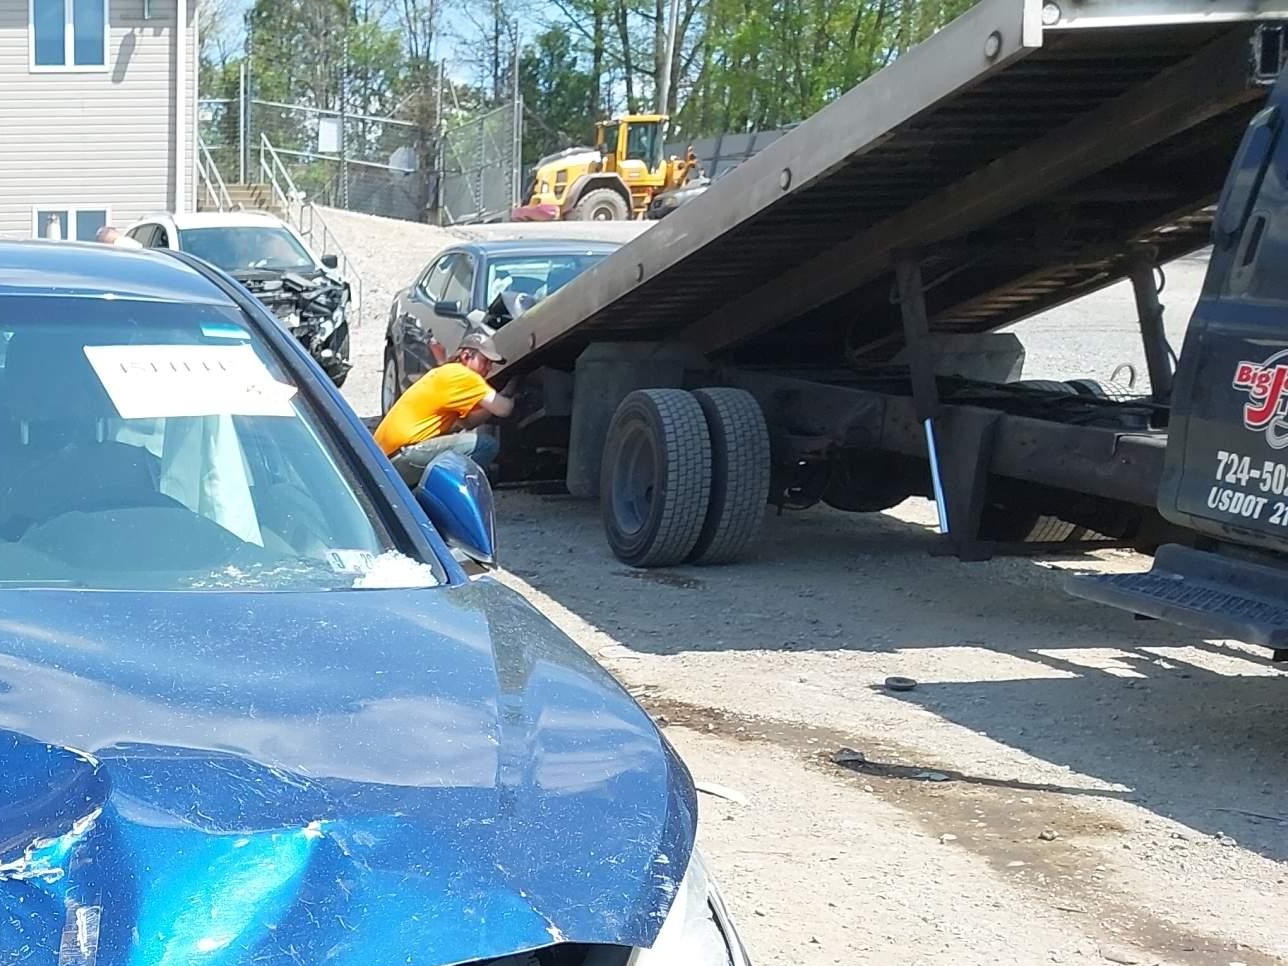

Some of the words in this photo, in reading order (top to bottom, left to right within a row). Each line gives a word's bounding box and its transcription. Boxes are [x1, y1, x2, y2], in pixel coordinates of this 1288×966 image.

[1236, 363, 1271, 397] Big
[1216, 451, 1288, 497] 724-50
[1207, 486, 1268, 519] USDOT
